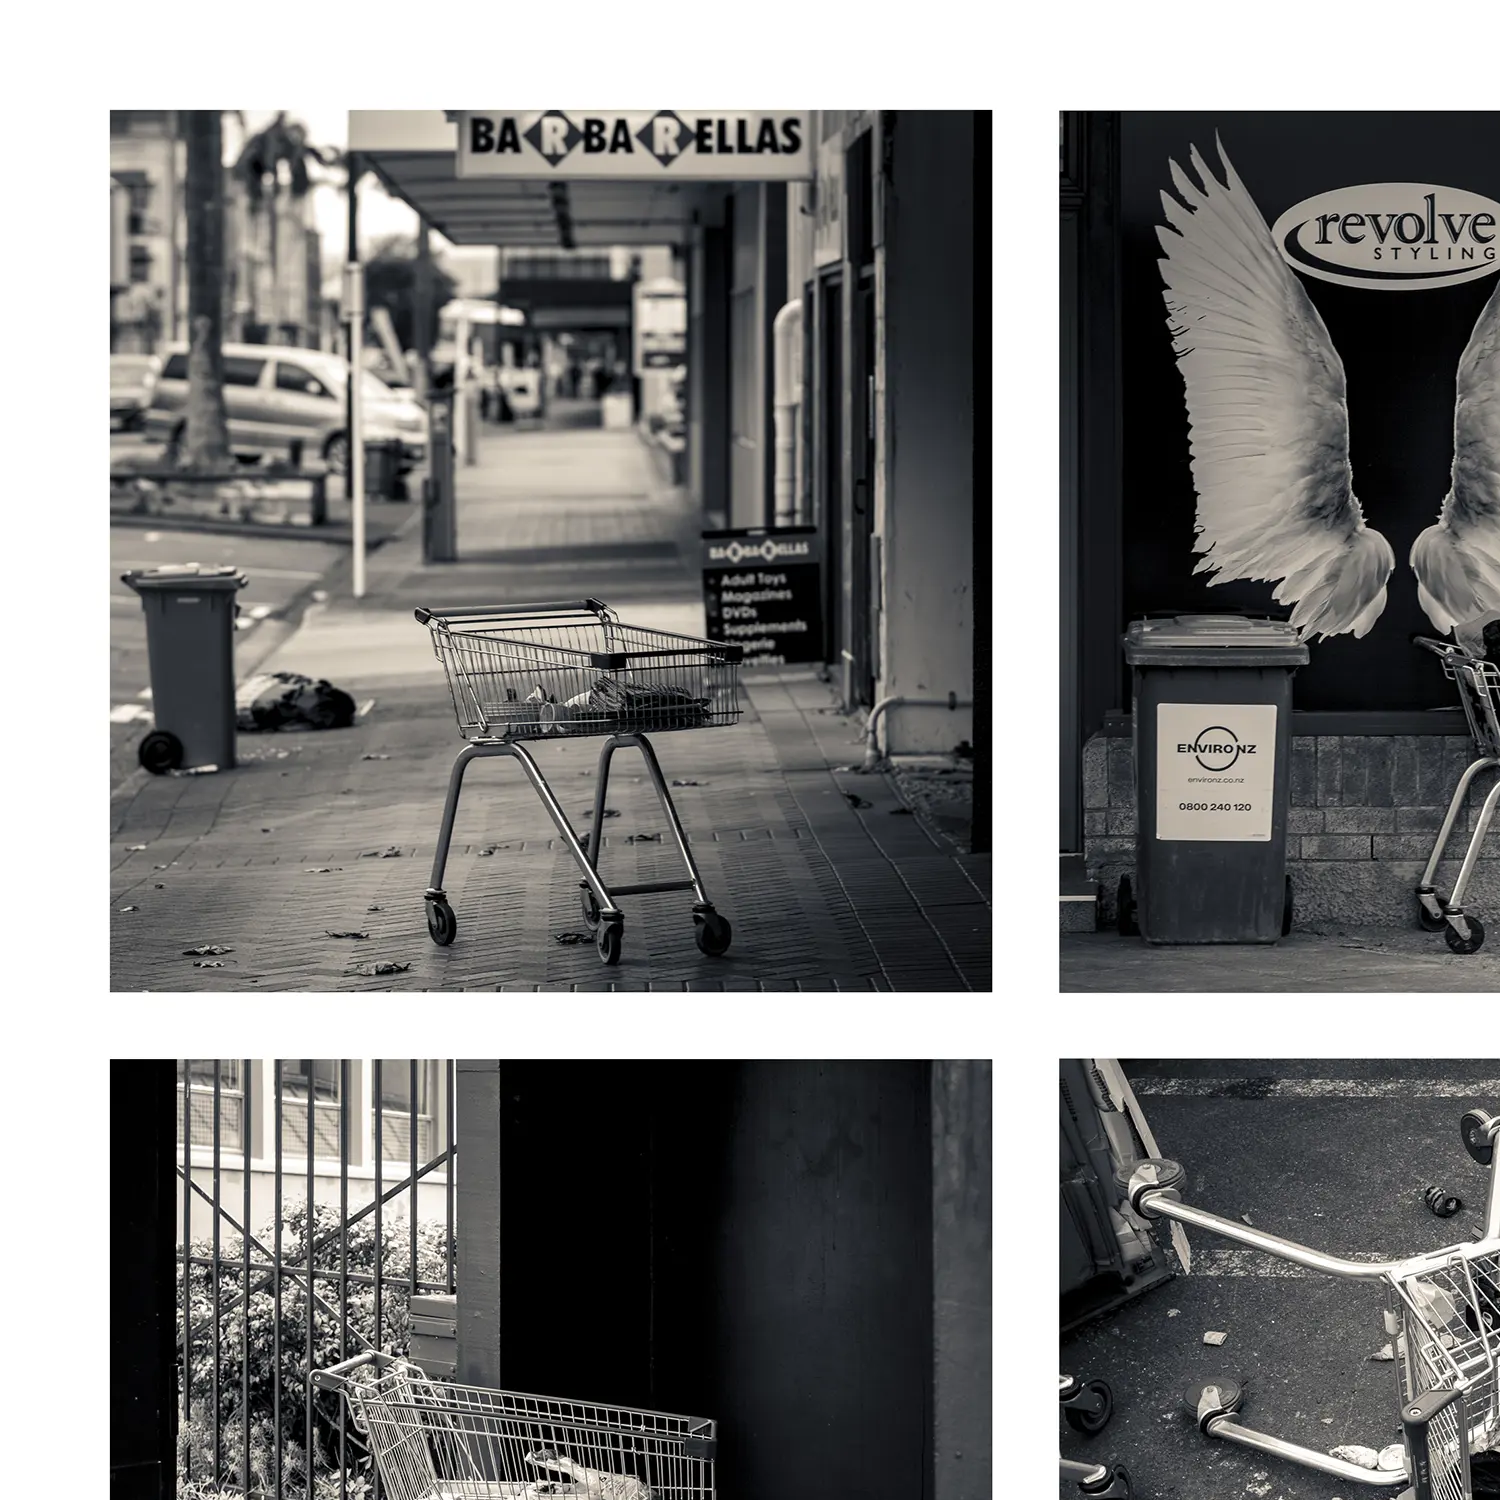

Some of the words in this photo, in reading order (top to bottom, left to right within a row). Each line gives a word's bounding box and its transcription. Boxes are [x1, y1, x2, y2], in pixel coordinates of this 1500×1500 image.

[470, 116, 803, 157] BARBARELLAS
[1315, 193, 1497, 244] revolve
[1374, 247, 1496, 260] STYLING
[721, 589, 793, 604] Magazines
[722, 606, 758, 619] DVDs
[723, 619, 808, 636] Supplements
[1187, 776, 1245, 784] environz.co.nz
[1179, 802, 1208, 811] 0800
[1210, 803, 1231, 812] 240
[1234, 803, 1252, 812] 120
